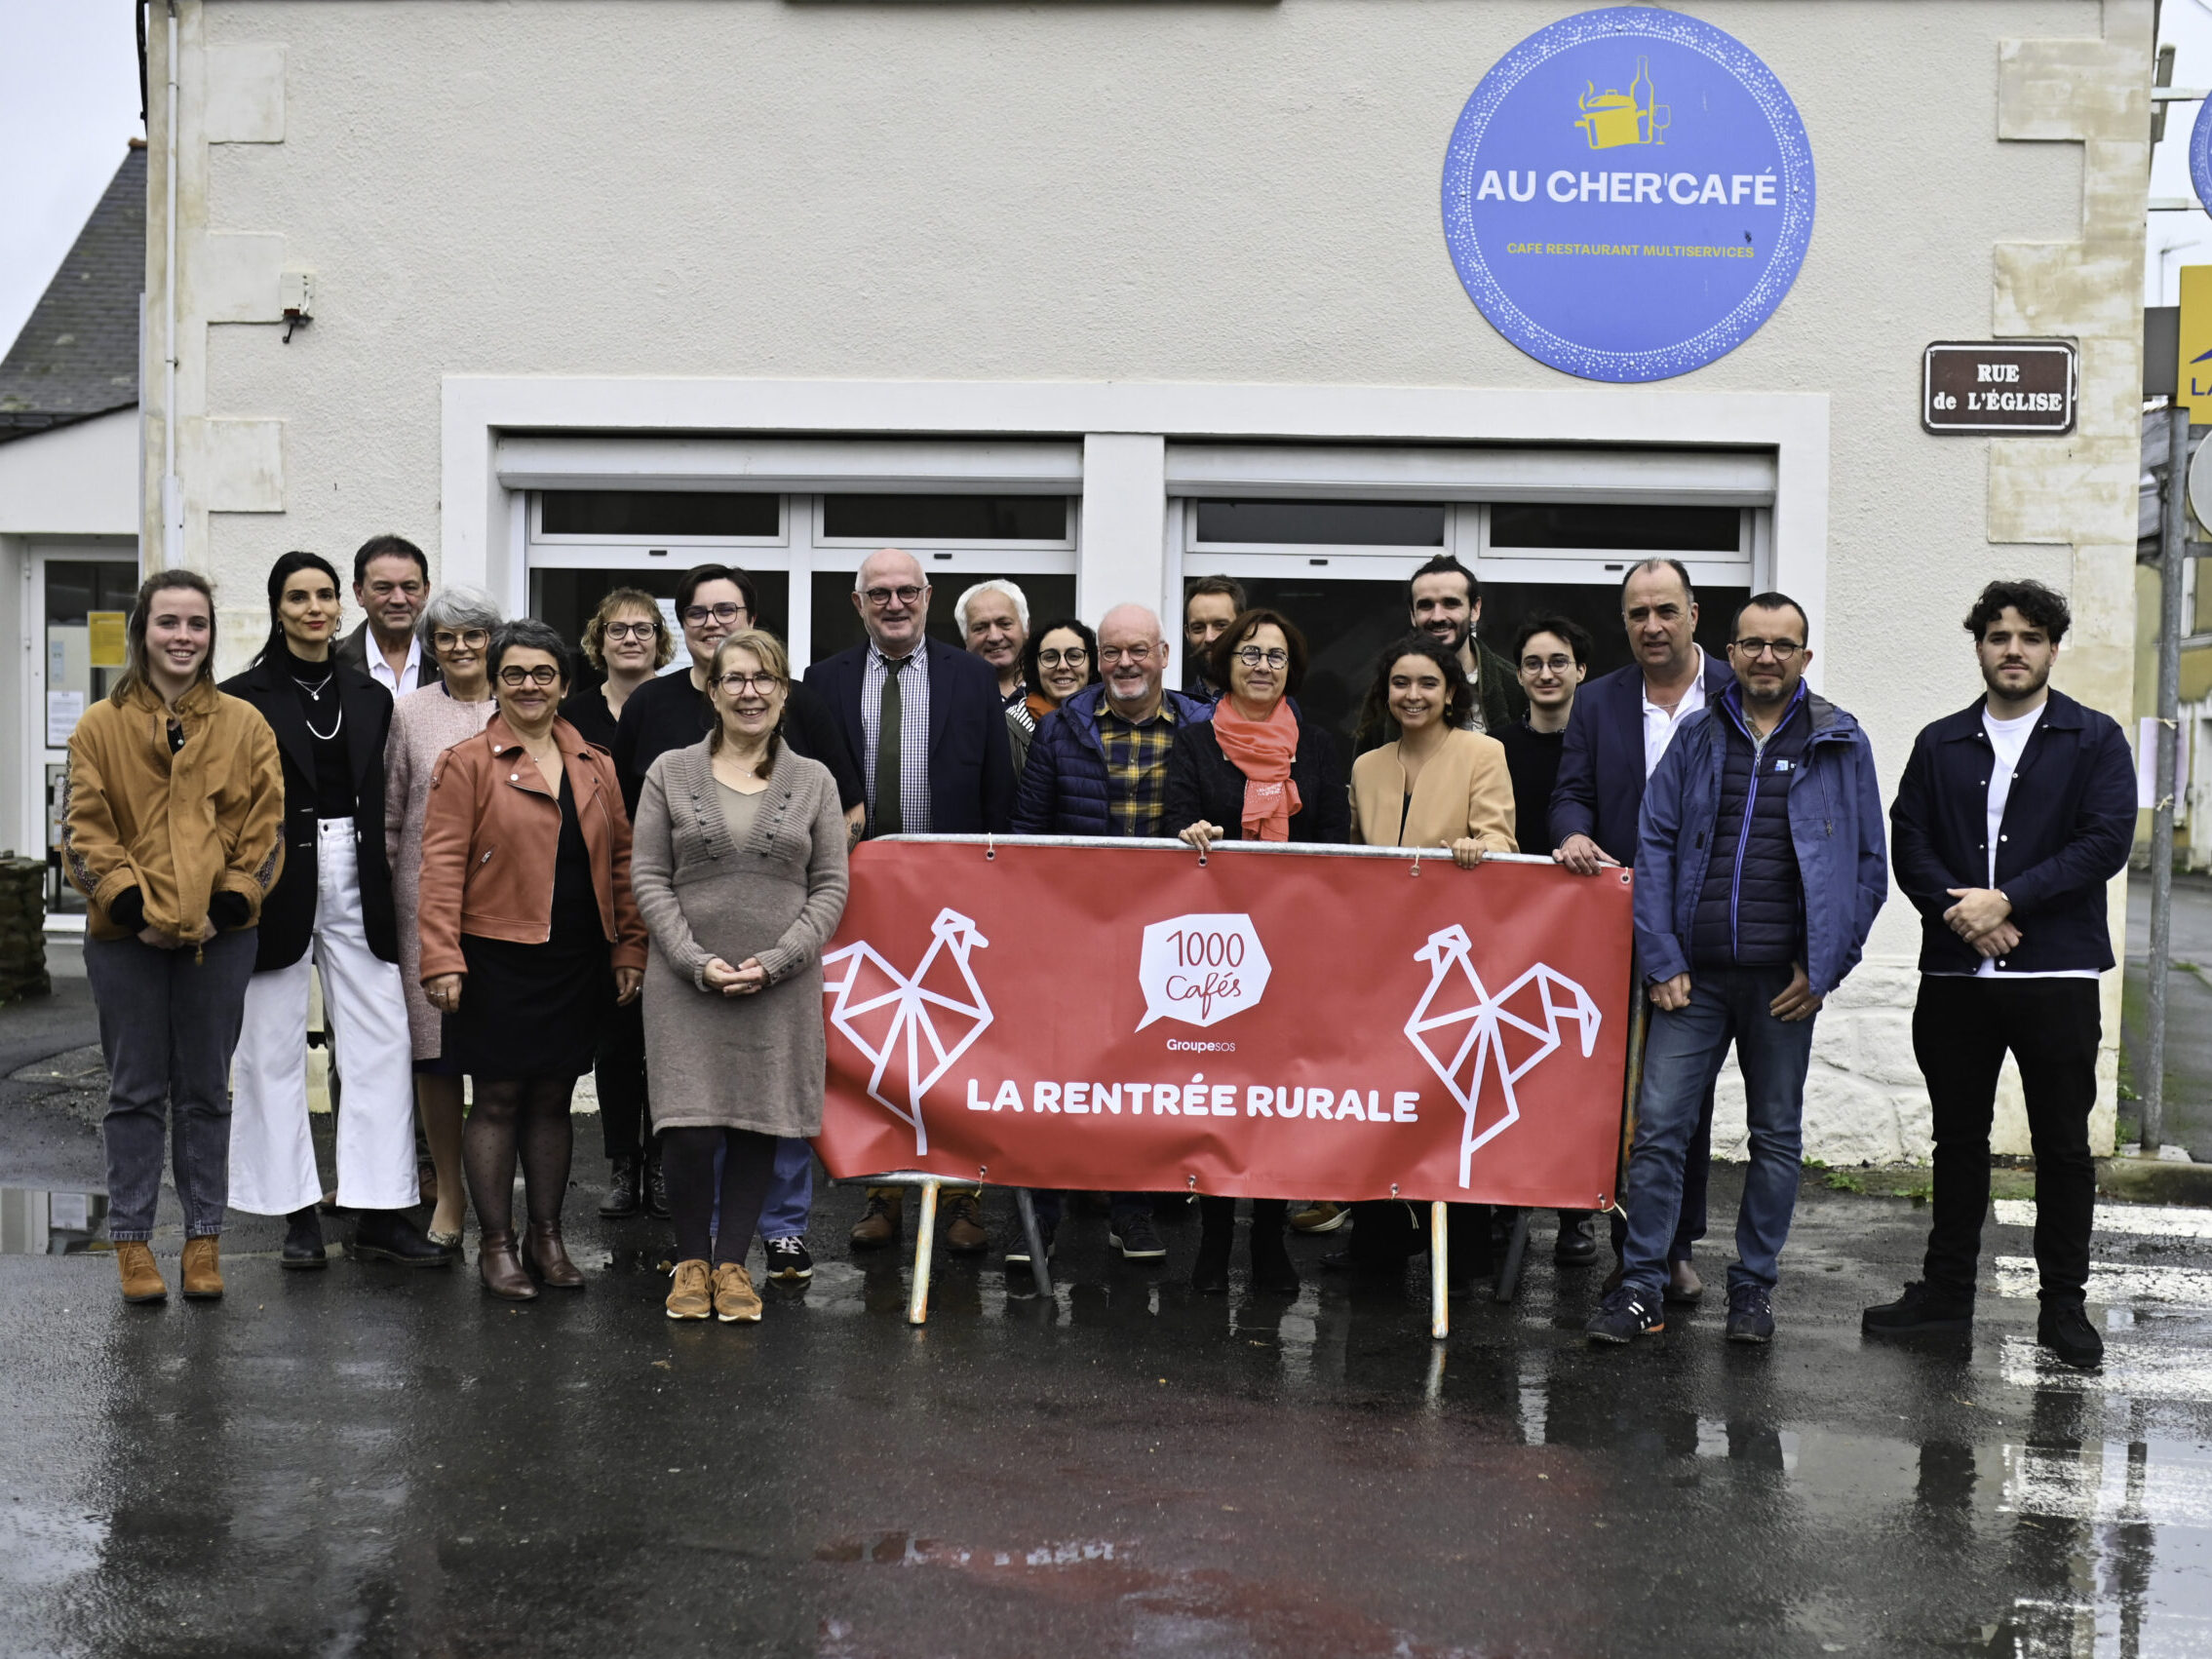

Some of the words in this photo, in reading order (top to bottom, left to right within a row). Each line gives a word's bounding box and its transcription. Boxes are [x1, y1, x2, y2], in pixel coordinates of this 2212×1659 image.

[1477, 170, 1536, 203] AU
[1546, 166, 1777, 206] CHER'CAFÉ
[1506, 242, 1543, 254] CAFE
[1545, 243, 1640, 256] RESTAURANT
[1642, 245, 1755, 258] MULTISERVICES
[1977, 364, 2020, 383] RUE
[1933, 391, 1958, 410] de
[1967, 388, 2063, 411] L'ÉGLISE
[1166, 930, 1245, 968] 1000
[1165, 971, 1242, 1021] Cafés
[966, 1077, 1025, 1113] LA
[1032, 1072, 1238, 1117] RENTRÉE
[1246, 1085, 1420, 1123] RURALE
